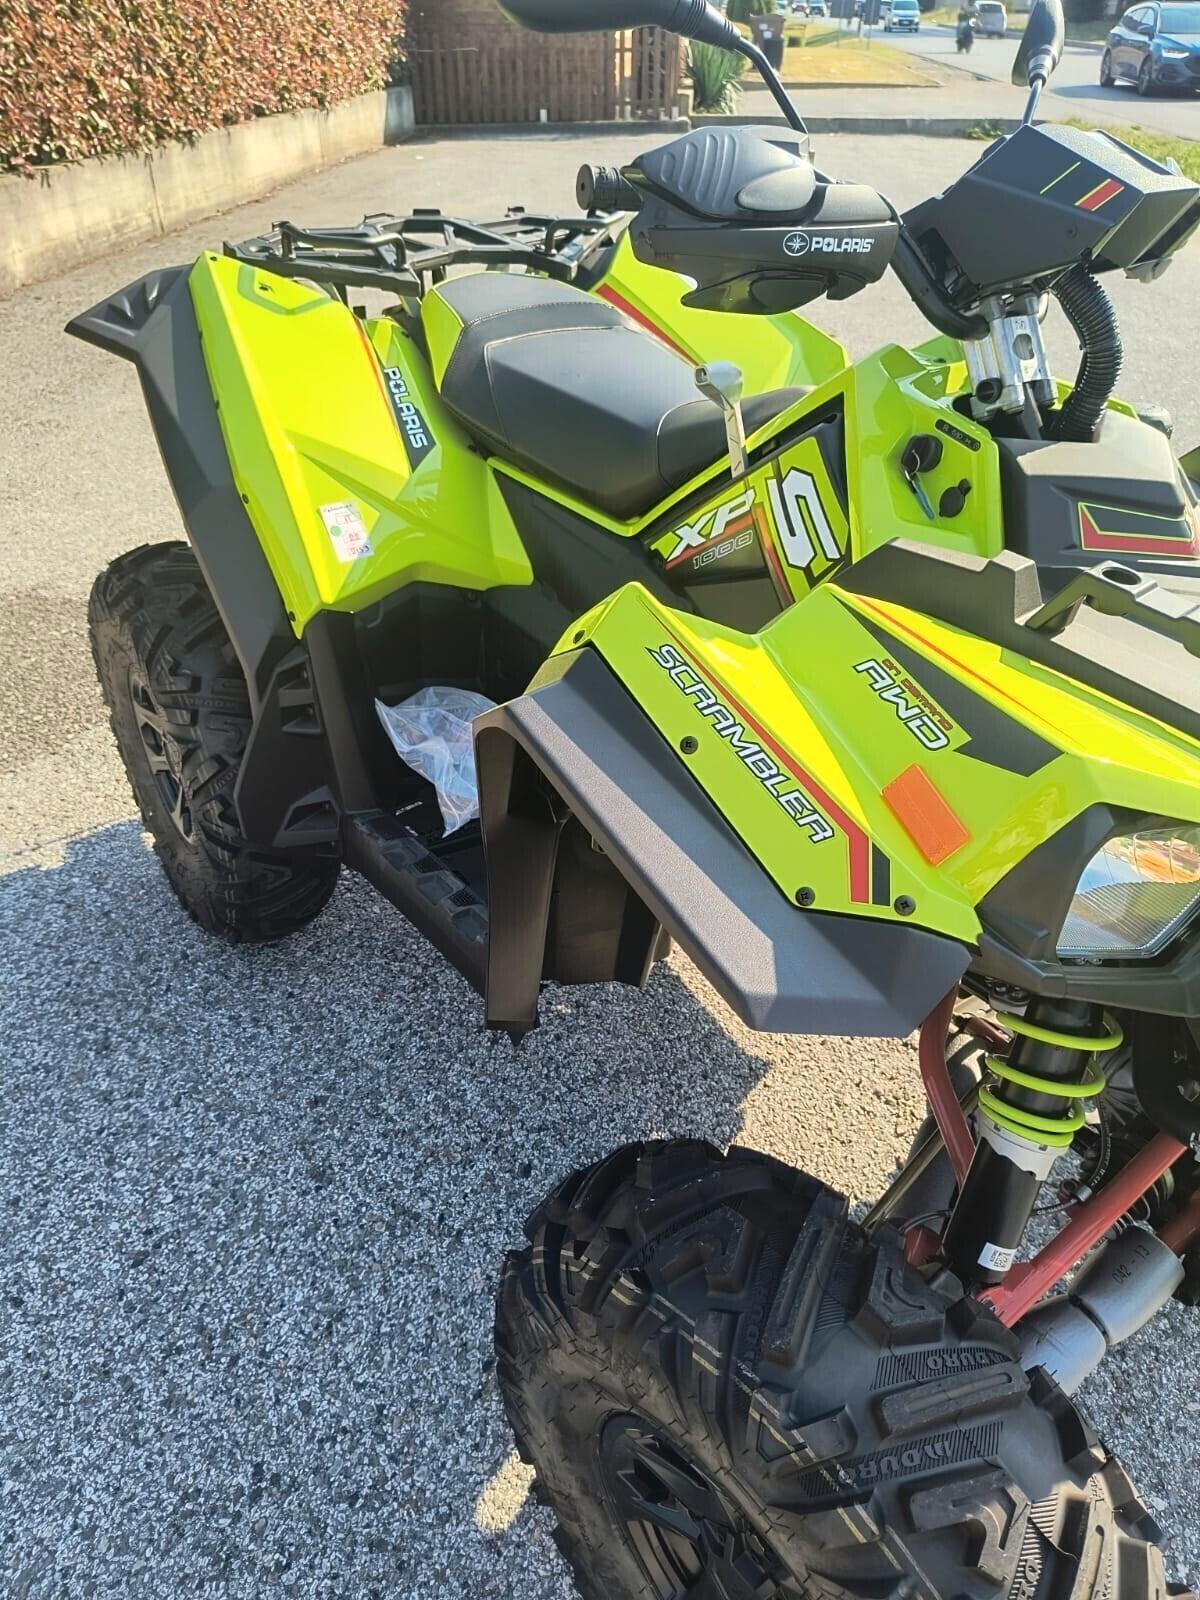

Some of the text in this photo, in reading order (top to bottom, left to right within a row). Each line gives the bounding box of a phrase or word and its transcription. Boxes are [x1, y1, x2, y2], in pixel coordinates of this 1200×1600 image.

[811, 237, 875, 253] POLARIS
[383, 366, 429, 449] POLARIS
[666, 488, 756, 562] XP
[692, 529, 754, 570] 1000
[645, 644, 835, 843] SCRAMBLER
[853, 659, 950, 751] AWD
